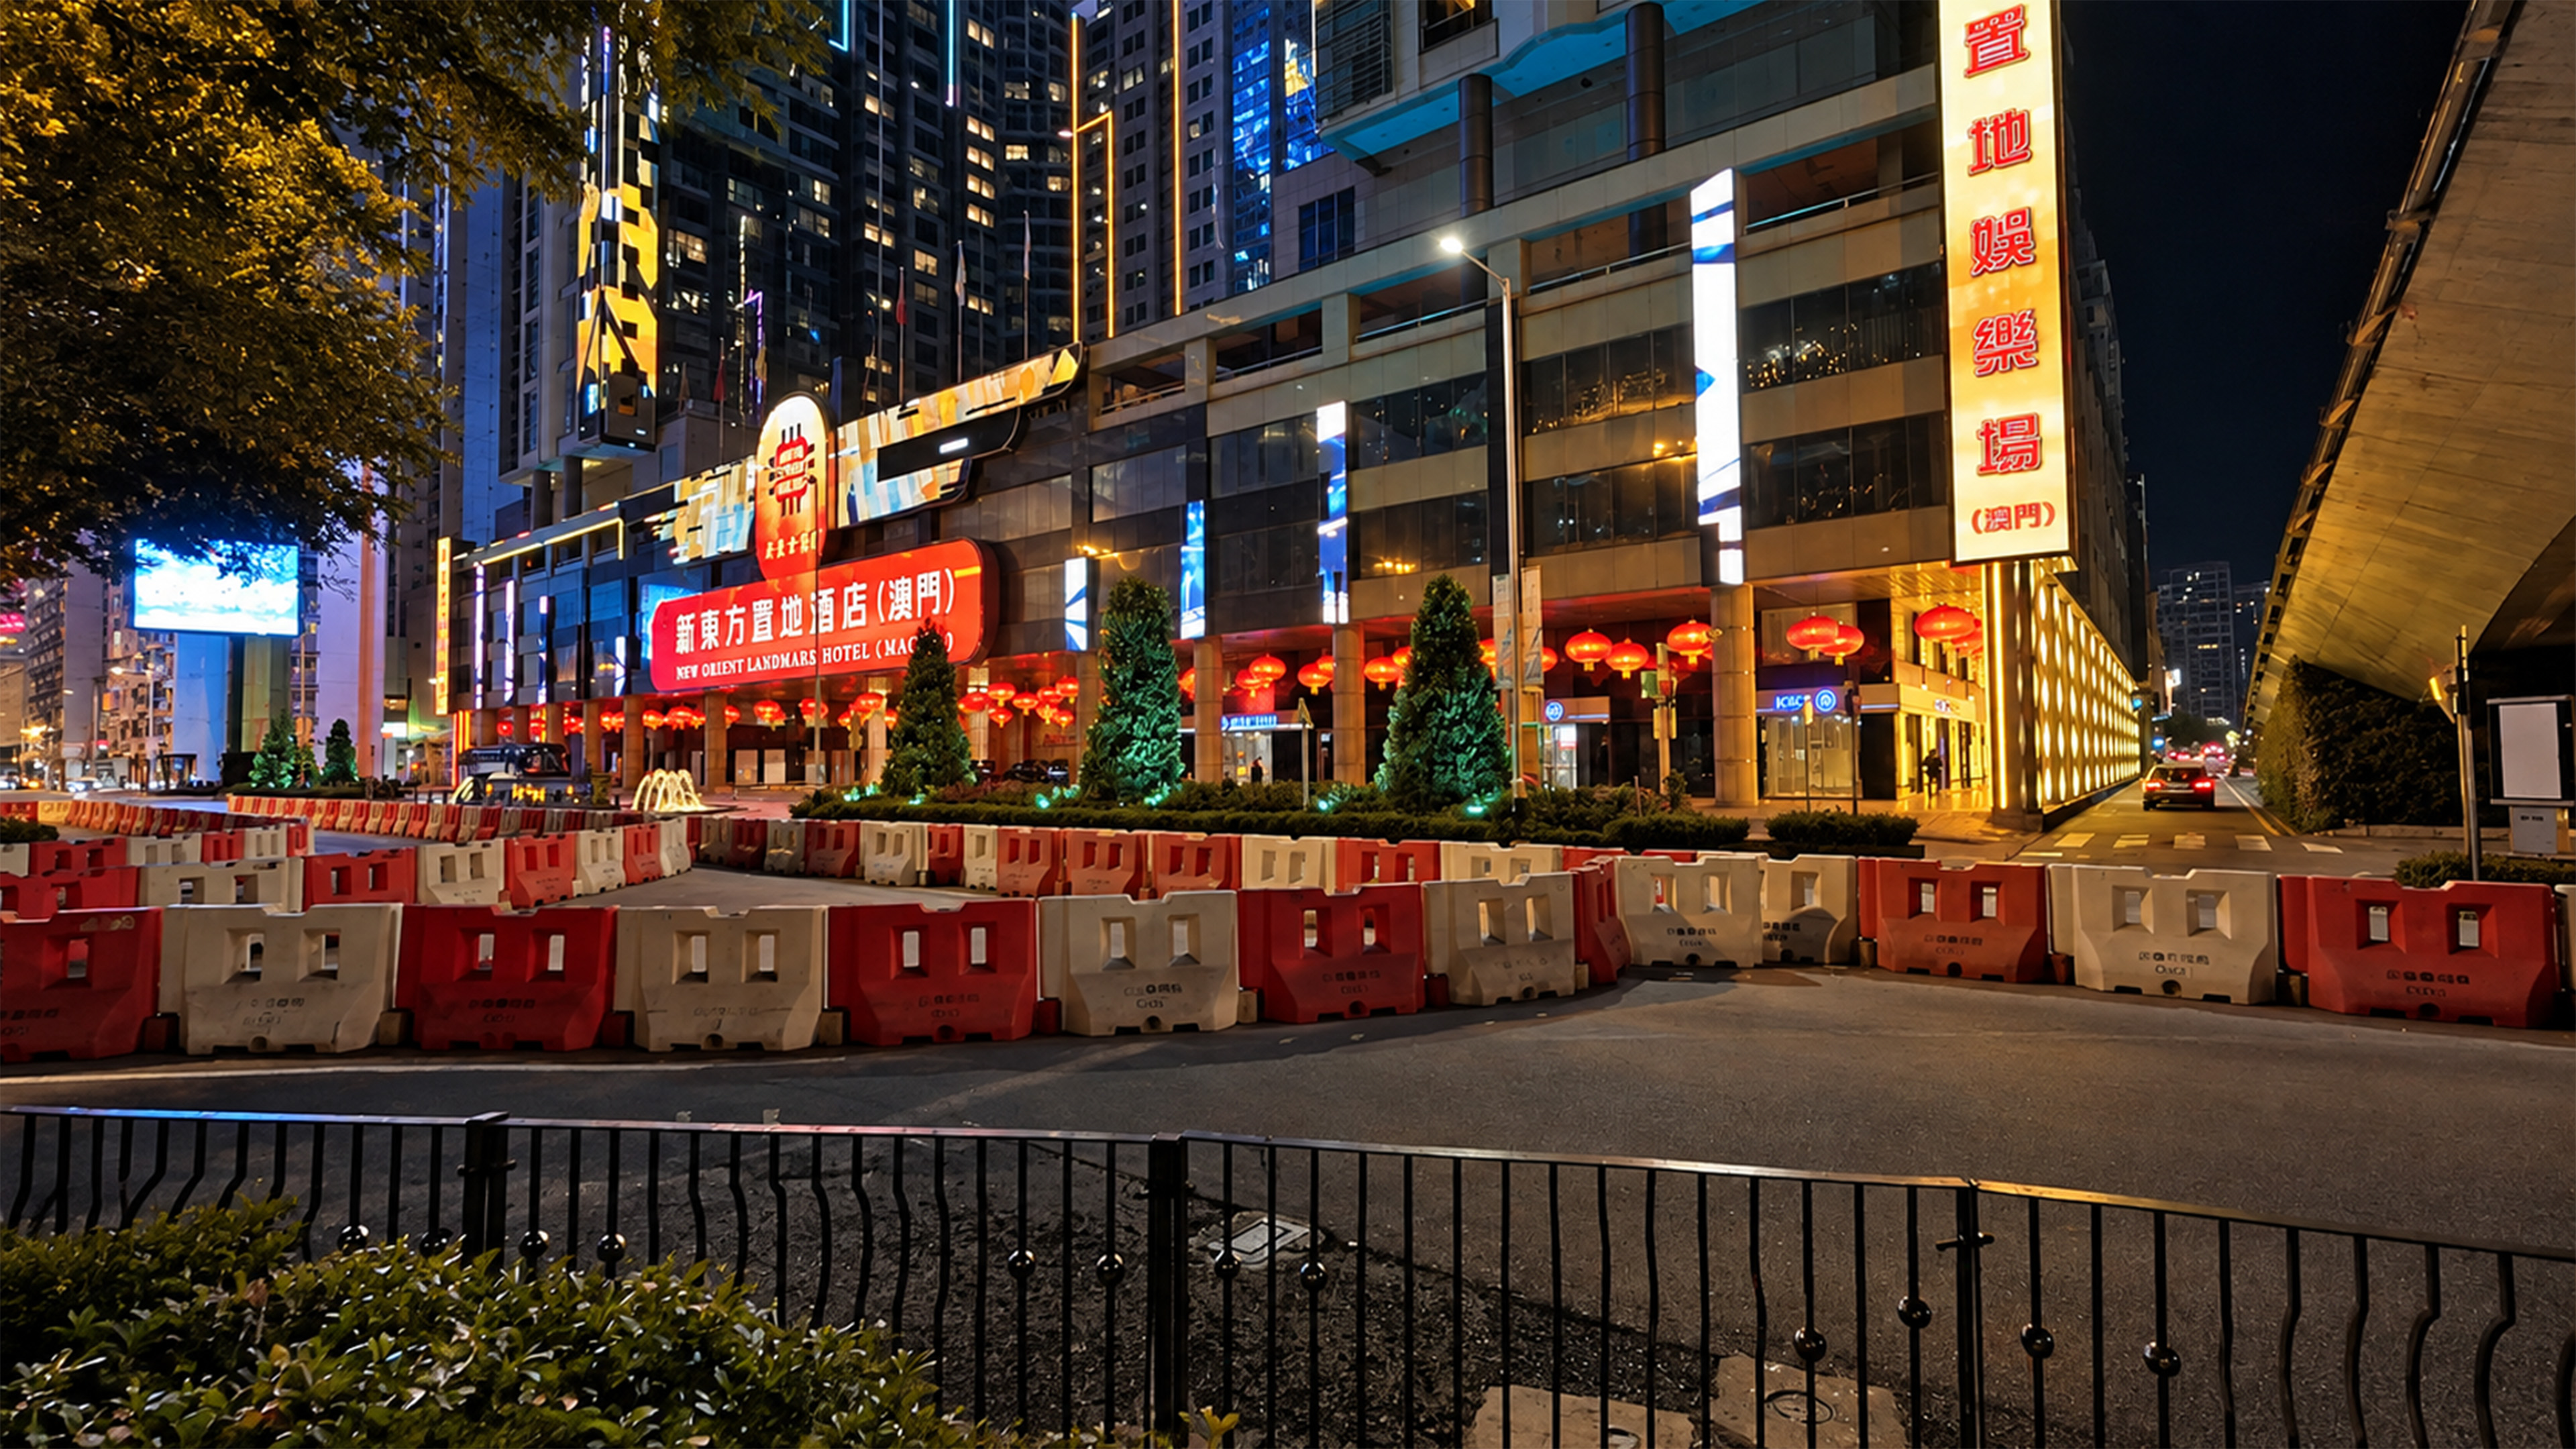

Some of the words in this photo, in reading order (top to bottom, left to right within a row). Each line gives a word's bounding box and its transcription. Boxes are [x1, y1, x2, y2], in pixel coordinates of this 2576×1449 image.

[1964, 3, 2043, 476] 置地娛樂場
[1972, 501, 2055, 535] (澳門)
[822, 642, 870, 664] HOTEL
[876, 632, 954, 659] (MAC)
